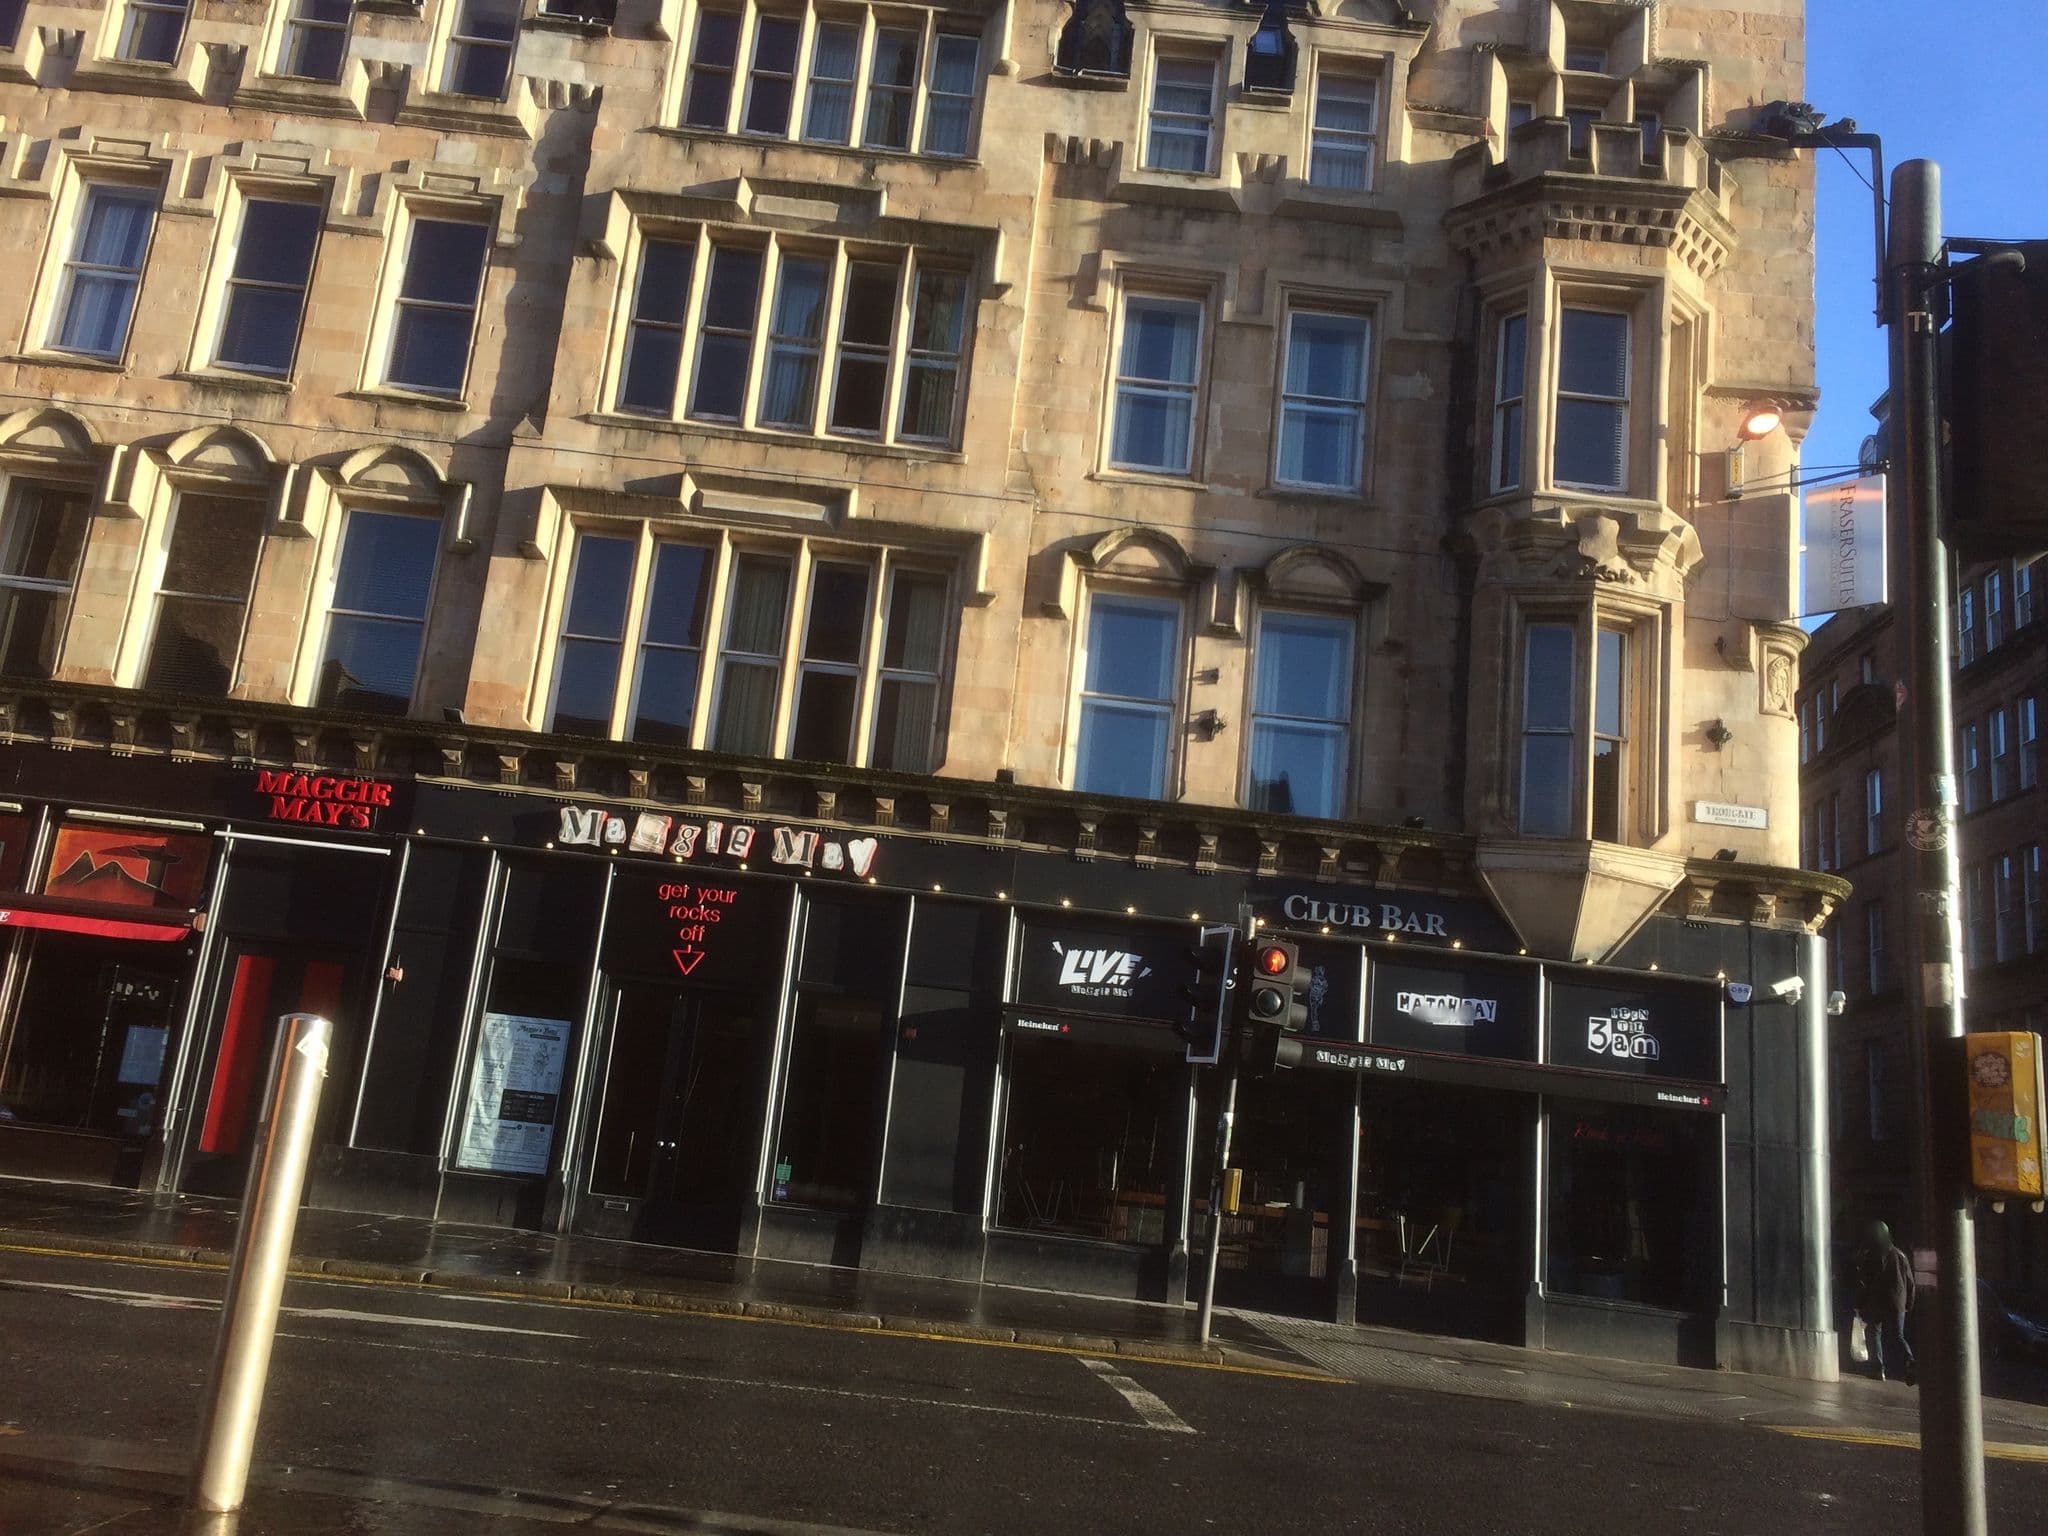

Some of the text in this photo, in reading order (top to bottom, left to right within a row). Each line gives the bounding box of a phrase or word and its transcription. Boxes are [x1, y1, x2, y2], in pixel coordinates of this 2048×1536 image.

[256, 770, 392, 807] MAGGIE
[268, 796, 370, 828] MAY'S
[658, 883, 738, 905] get your
[669, 904, 721, 922] rocks
[1283, 894, 1448, 937] CLUB BAR
[680, 924, 706, 942] off
[1058, 948, 1144, 985] LIVE
[1105, 973, 1132, 986] AT
[1017, 1019, 1059, 1031] Heineken
[1587, 1016, 1660, 1060] 3am
[1656, 1091, 1701, 1104] Heineken
